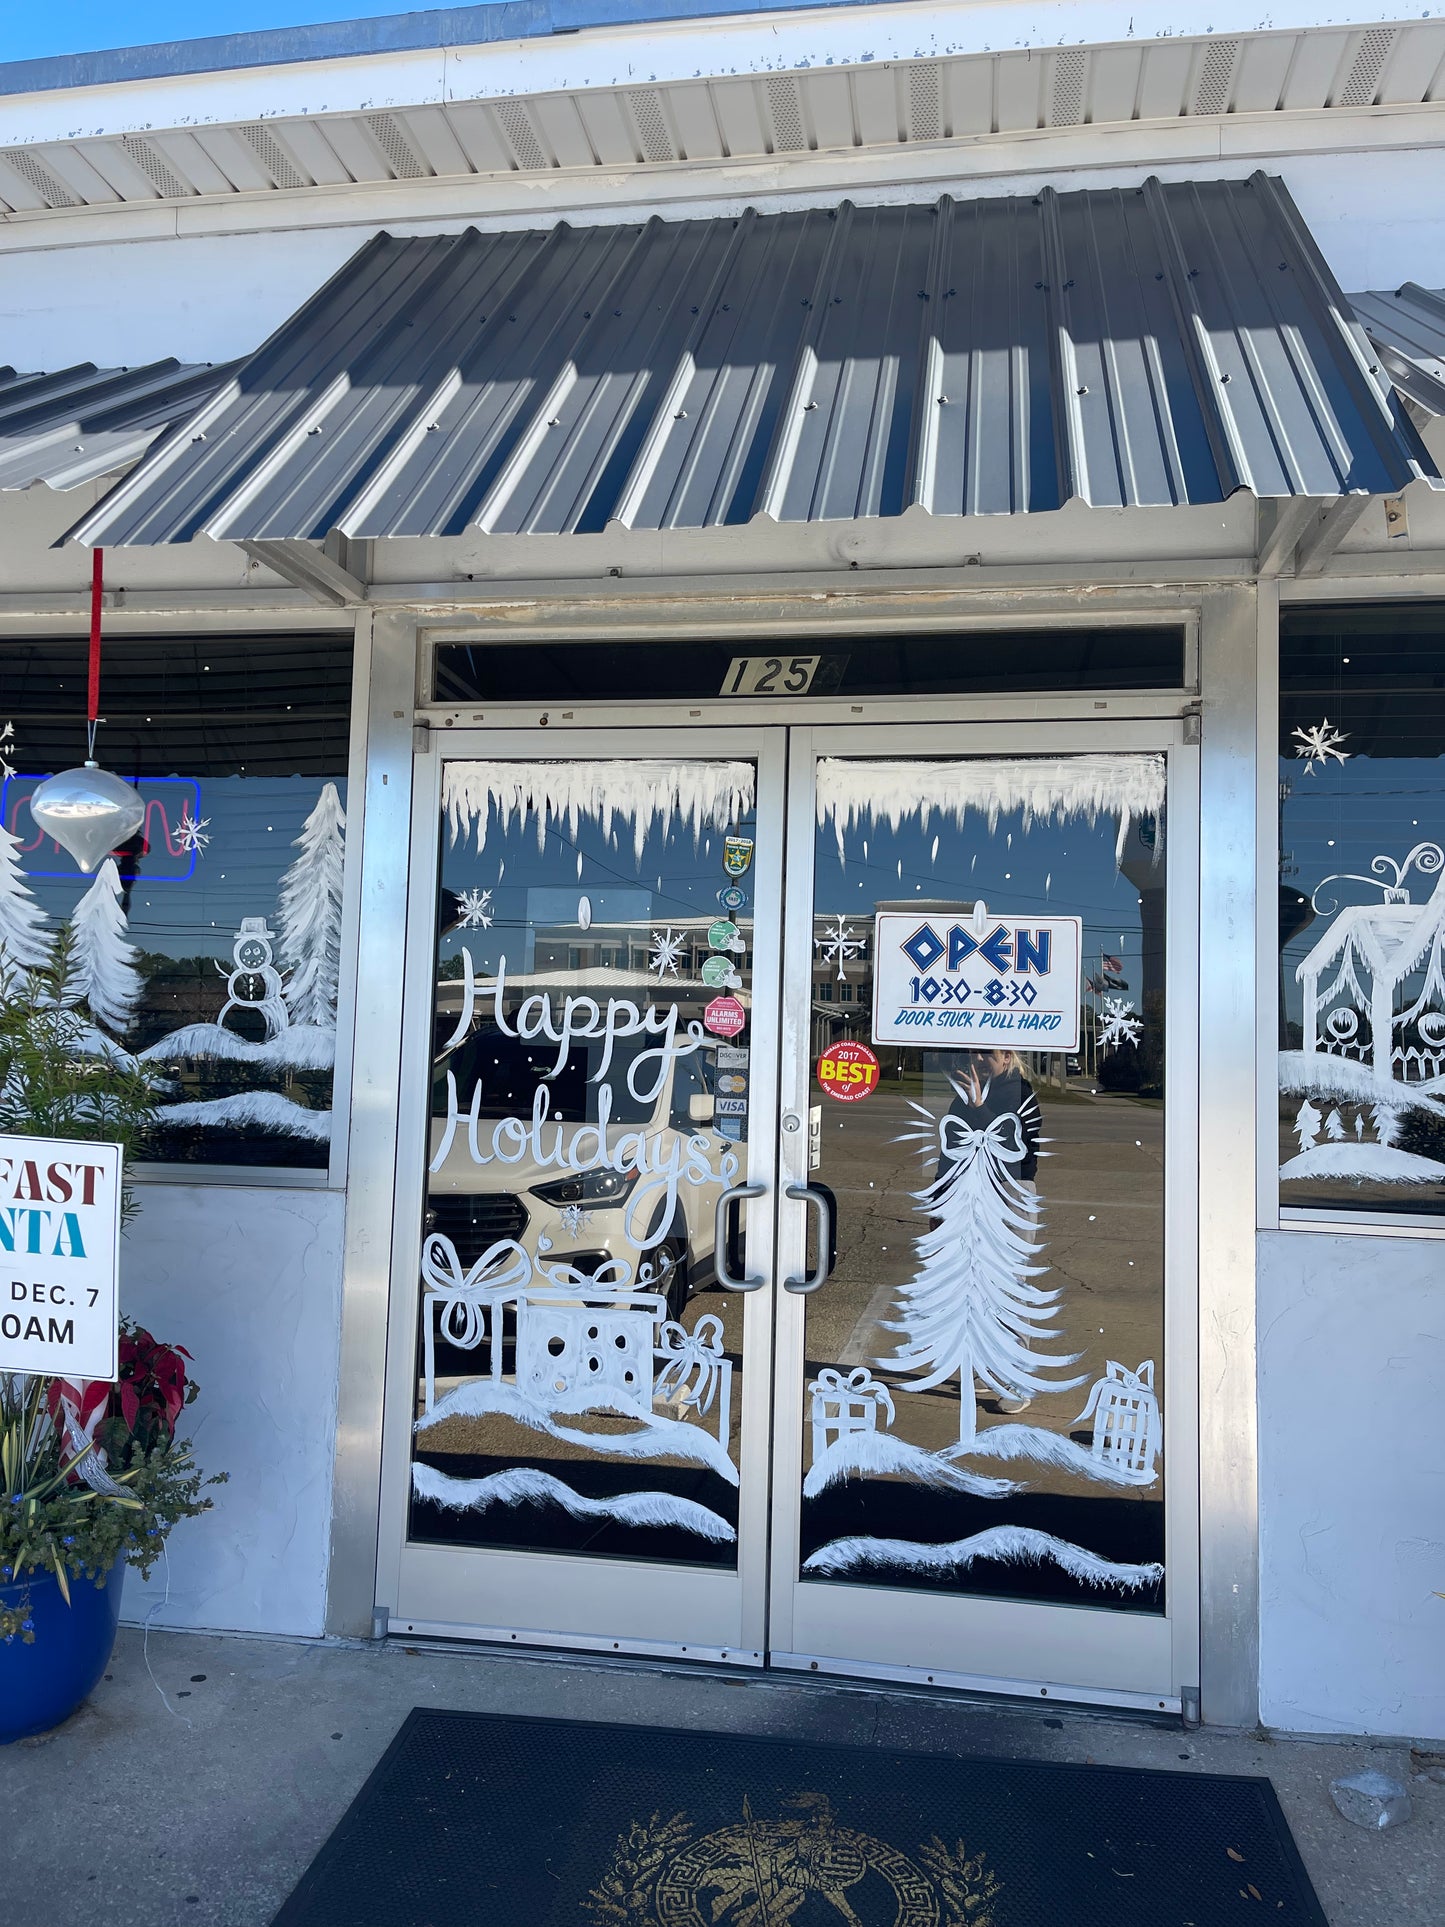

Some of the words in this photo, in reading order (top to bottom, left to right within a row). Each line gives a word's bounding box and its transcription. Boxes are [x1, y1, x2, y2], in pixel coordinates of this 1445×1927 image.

[731, 658, 813, 692] 125
[900, 922, 1052, 977] OPEN
[909, 976, 1038, 1007] 10:30-8:30
[443, 946, 718, 1103] Happy
[707, 1016, 742, 1025] UNLIMITED
[711, 1010, 739, 1019] ALARMS
[894, 1009, 935, 1026] DOOR
[937, 1010, 975, 1028] STUCK
[979, 1012, 1015, 1030] PULL
[1017, 1013, 1062, 1031] HARD
[823, 1044, 840, 1058] EMERALD
[856, 1044, 876, 1063] MAGAZINE
[838, 1050, 859, 1060] 2017
[820, 1059, 877, 1084] BEST
[823, 1082, 831, 1092] THE
[830, 1090, 854, 1100] EMERALD
[855, 1087, 871, 1099] COAST
[842, 1083, 853, 1092] of
[720, 1101, 745, 1112] VISA
[429, 1069, 739, 1250] Holidays
[11, 1281, 74, 1306] DEC.
[86, 1288, 99, 1308] 7
